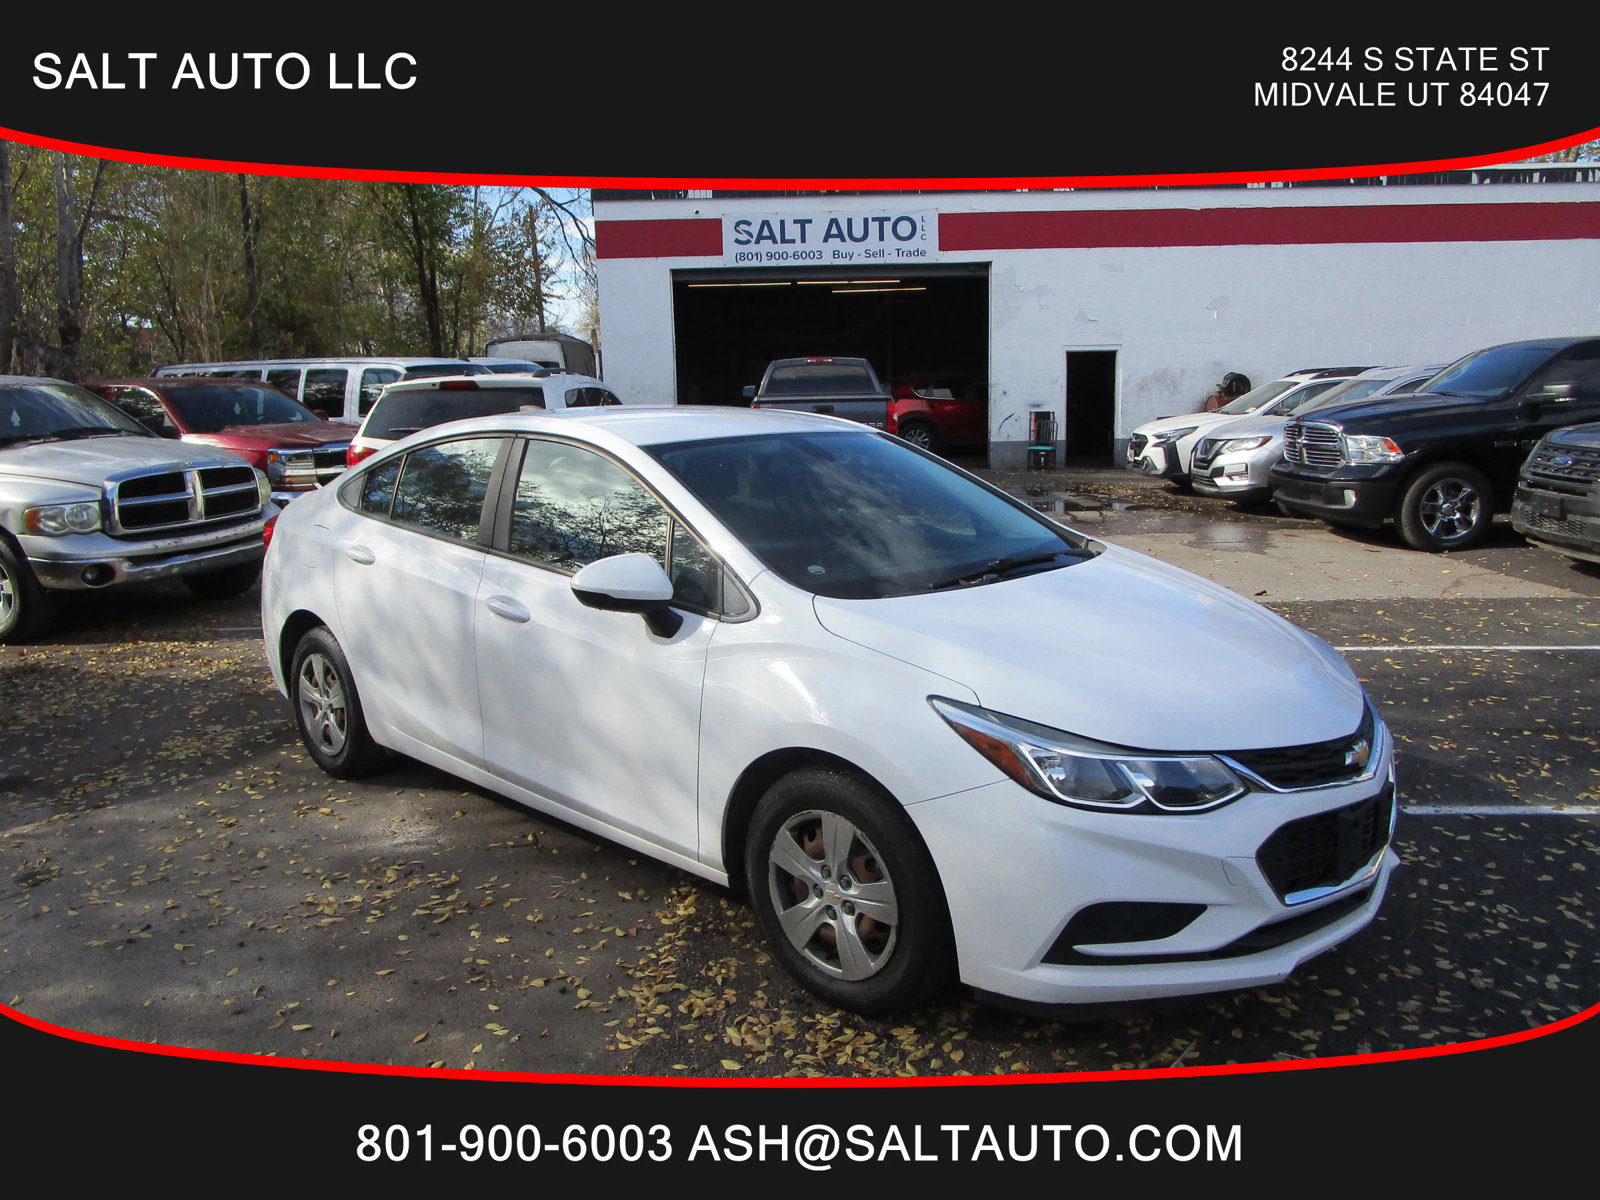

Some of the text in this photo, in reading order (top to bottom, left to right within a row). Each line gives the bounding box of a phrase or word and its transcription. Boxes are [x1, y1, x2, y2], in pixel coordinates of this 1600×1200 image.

[734, 215, 918, 246] SALT AUTO
[734, 250, 763, 263] (801)
[765, 249, 823, 262] 900-6003
[832, 249, 855, 262] Buy
[864, 248, 886, 260] Sell
[894, 247, 927, 259] Trade
